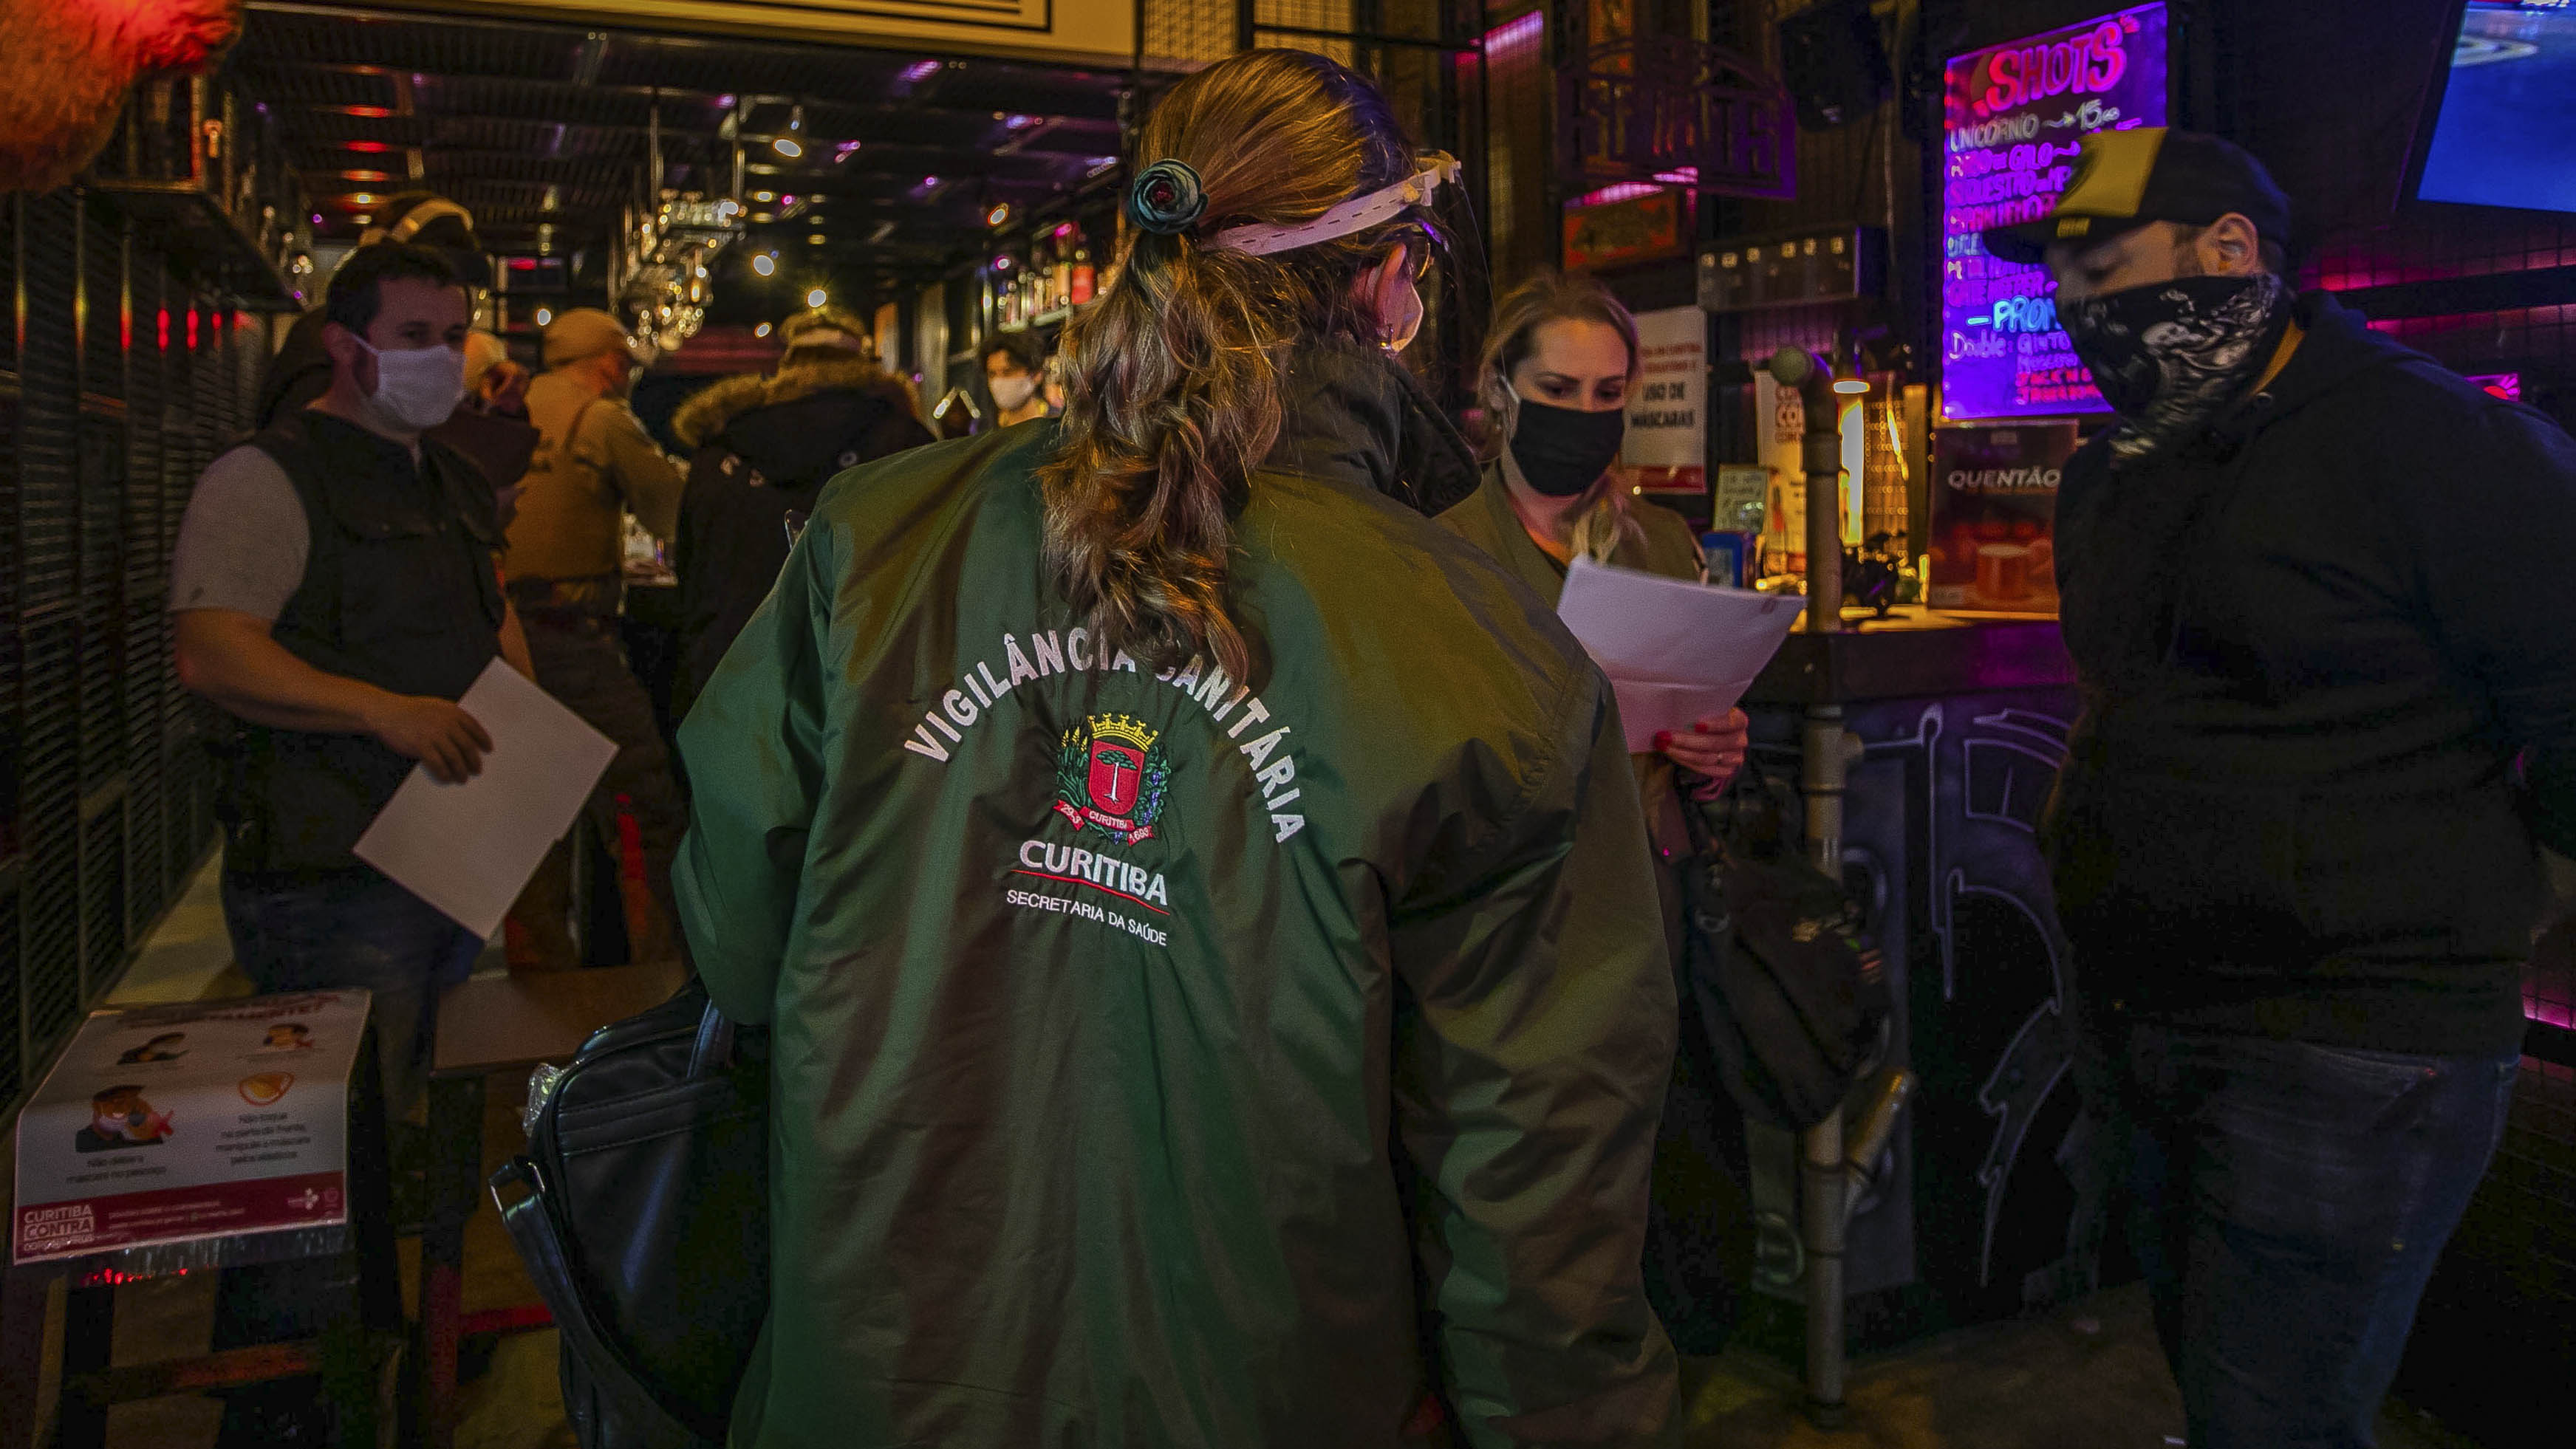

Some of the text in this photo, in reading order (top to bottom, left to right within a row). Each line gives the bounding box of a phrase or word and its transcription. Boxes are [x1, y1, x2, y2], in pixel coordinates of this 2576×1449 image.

[1985, 21, 2128, 112] SHOTS
[1947, 465, 2062, 490] QUENTÃO
[1019, 840, 1168, 906] CURITIBA
[1006, 889, 1168, 947] SECRETARIA DA SAÚDE
[24, 1204, 92, 1224] CURITIBA
[24, 1219, 91, 1239] CONTRA
